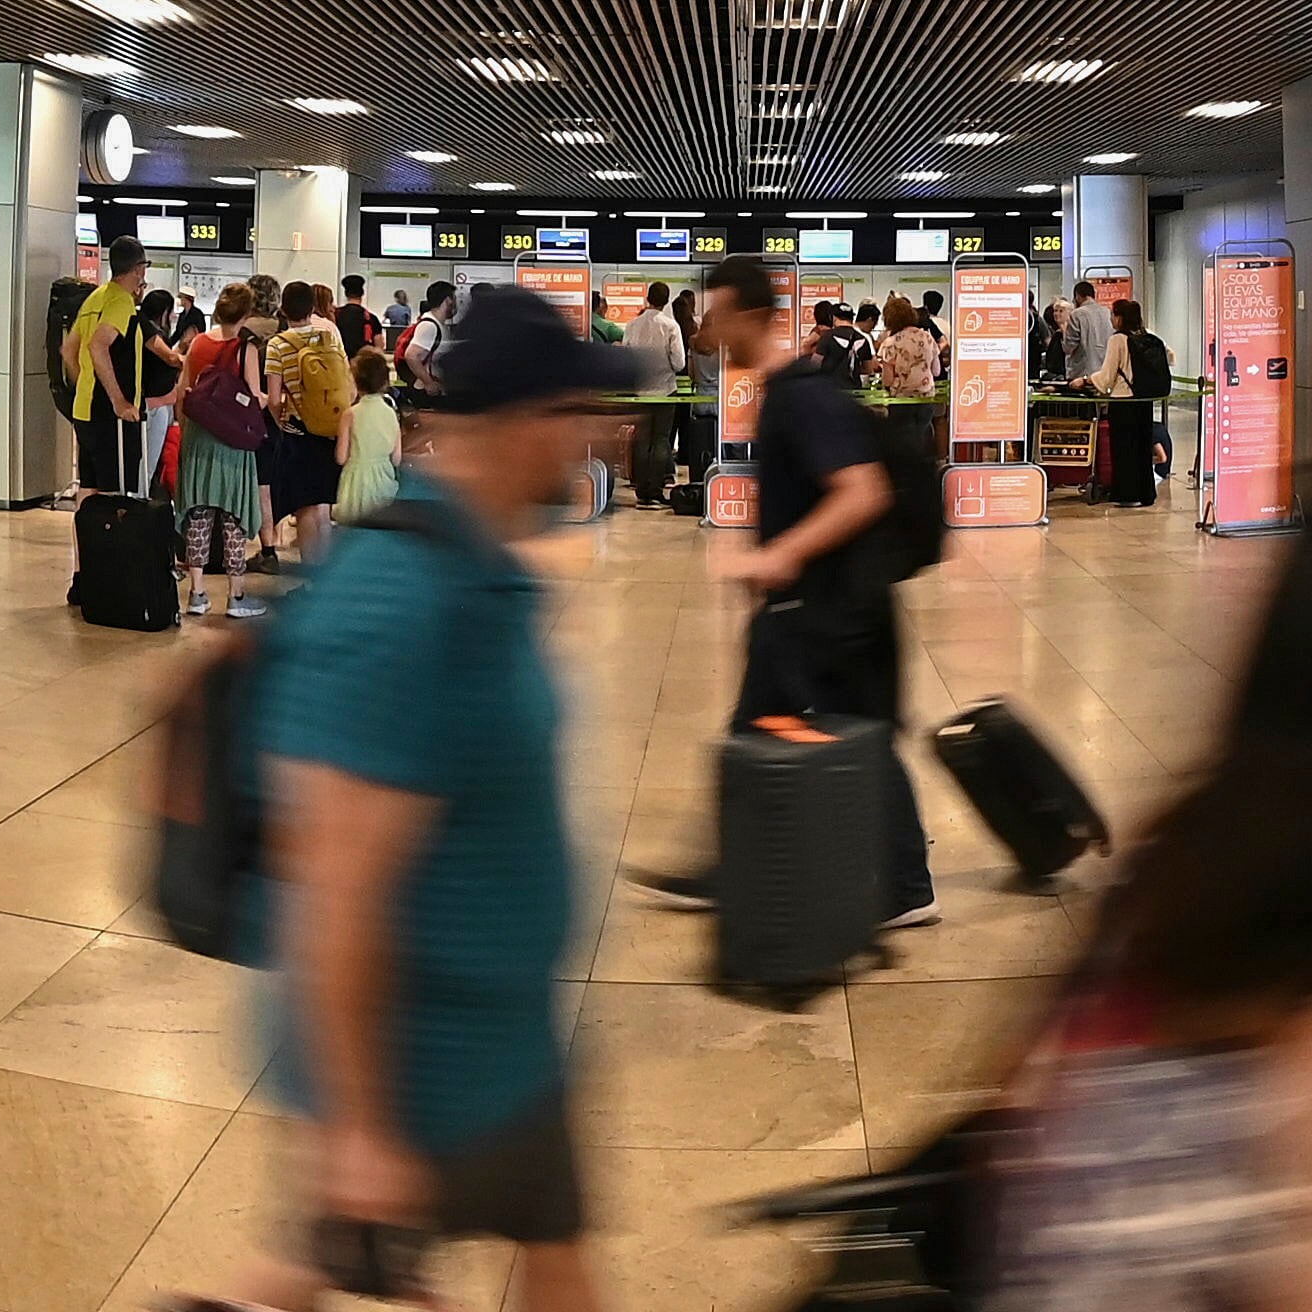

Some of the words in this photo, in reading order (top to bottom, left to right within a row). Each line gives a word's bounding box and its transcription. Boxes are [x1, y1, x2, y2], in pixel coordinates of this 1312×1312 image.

[191, 225, 219, 243] 333
[439, 234, 465, 247] 331
[504, 235, 532, 249] 330
[695, 237, 725, 253] 329
[766, 238, 794, 252] 328
[954, 238, 981, 251] 327
[1034, 237, 1060, 250] 326
[554, 272, 563, 283] DE
[563, 274, 582, 282] MANO
[991, 276, 1000, 284] DE
[1001, 276, 1020, 284] MANO
[1223, 273, 1259, 287] ¿SOLO
[1223, 285, 1263, 296] LLEVAS
[1224, 296, 1273, 308] EQUIPAJE
[1224, 309, 1239, 320] DE
[1242, 307, 1284, 319] MANO?
